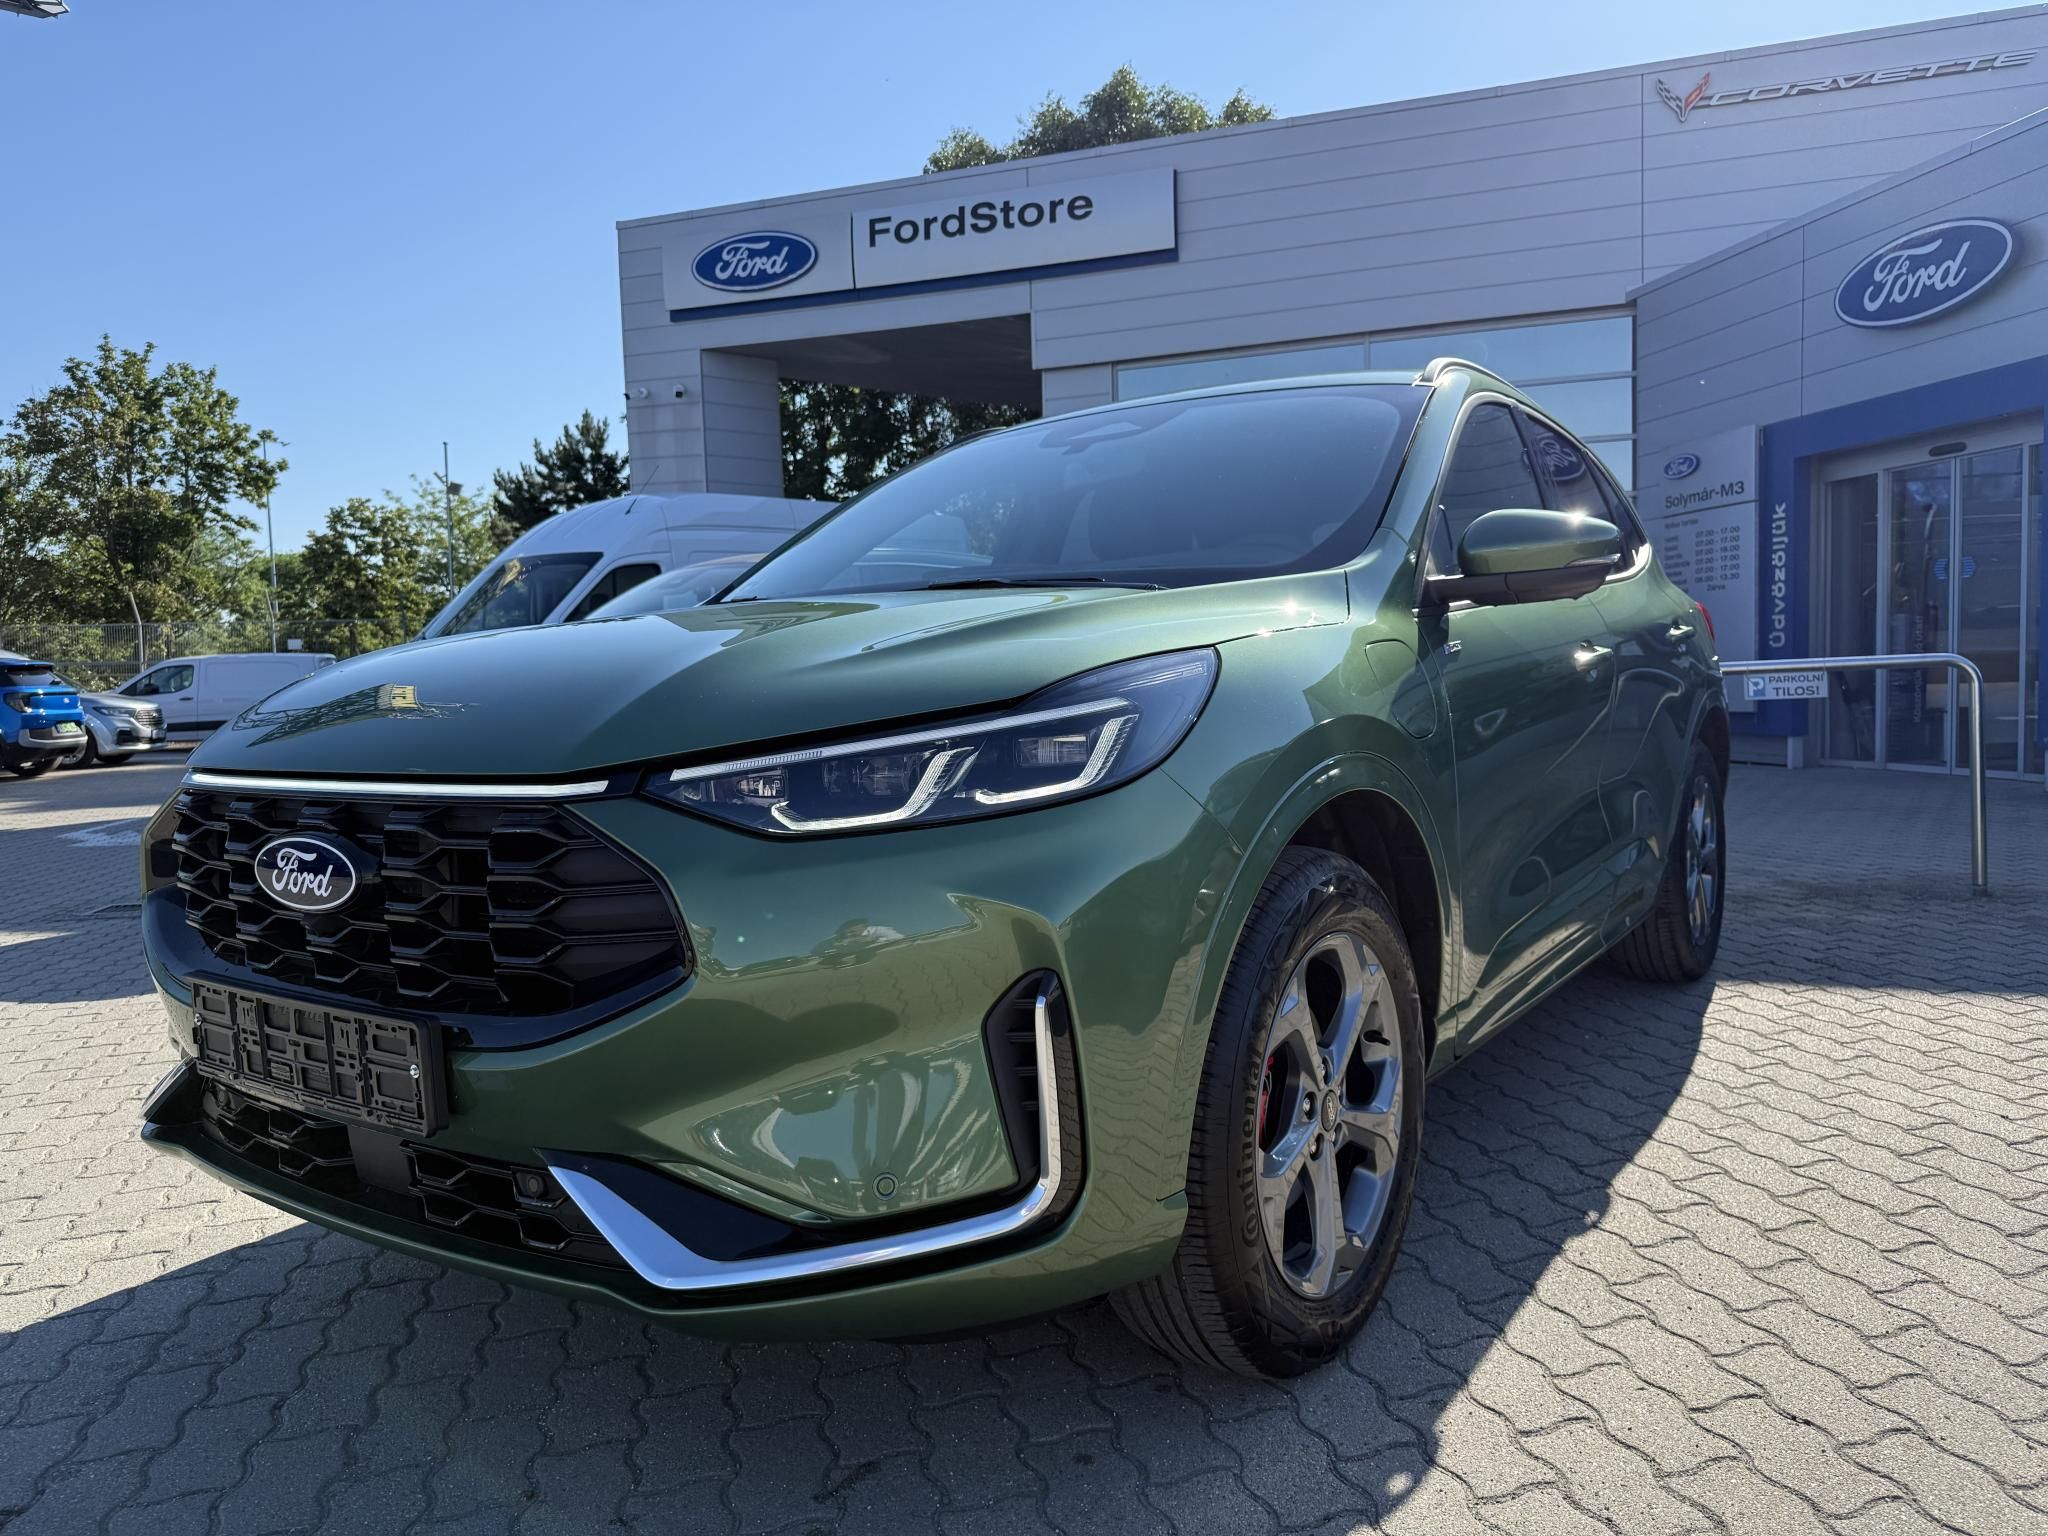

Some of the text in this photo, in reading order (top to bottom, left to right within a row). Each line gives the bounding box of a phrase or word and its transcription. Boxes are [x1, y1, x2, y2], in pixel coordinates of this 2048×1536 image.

[1708, 49, 2039, 106] CORVETTE
[868, 194, 1095, 248] FordStore
[714, 240, 789, 281] Ford
[1862, 238, 1972, 312] Ford
[1664, 480, 1745, 509] Solymár-M3
[1769, 502, 1789, 647] Üdvözöljük
[1769, 672, 1825, 684] PARKOLNÍ
[1772, 685, 1820, 697] TILOS!
[271, 847, 334, 900] Ford
[1238, 1041, 1263, 1249] Continental
